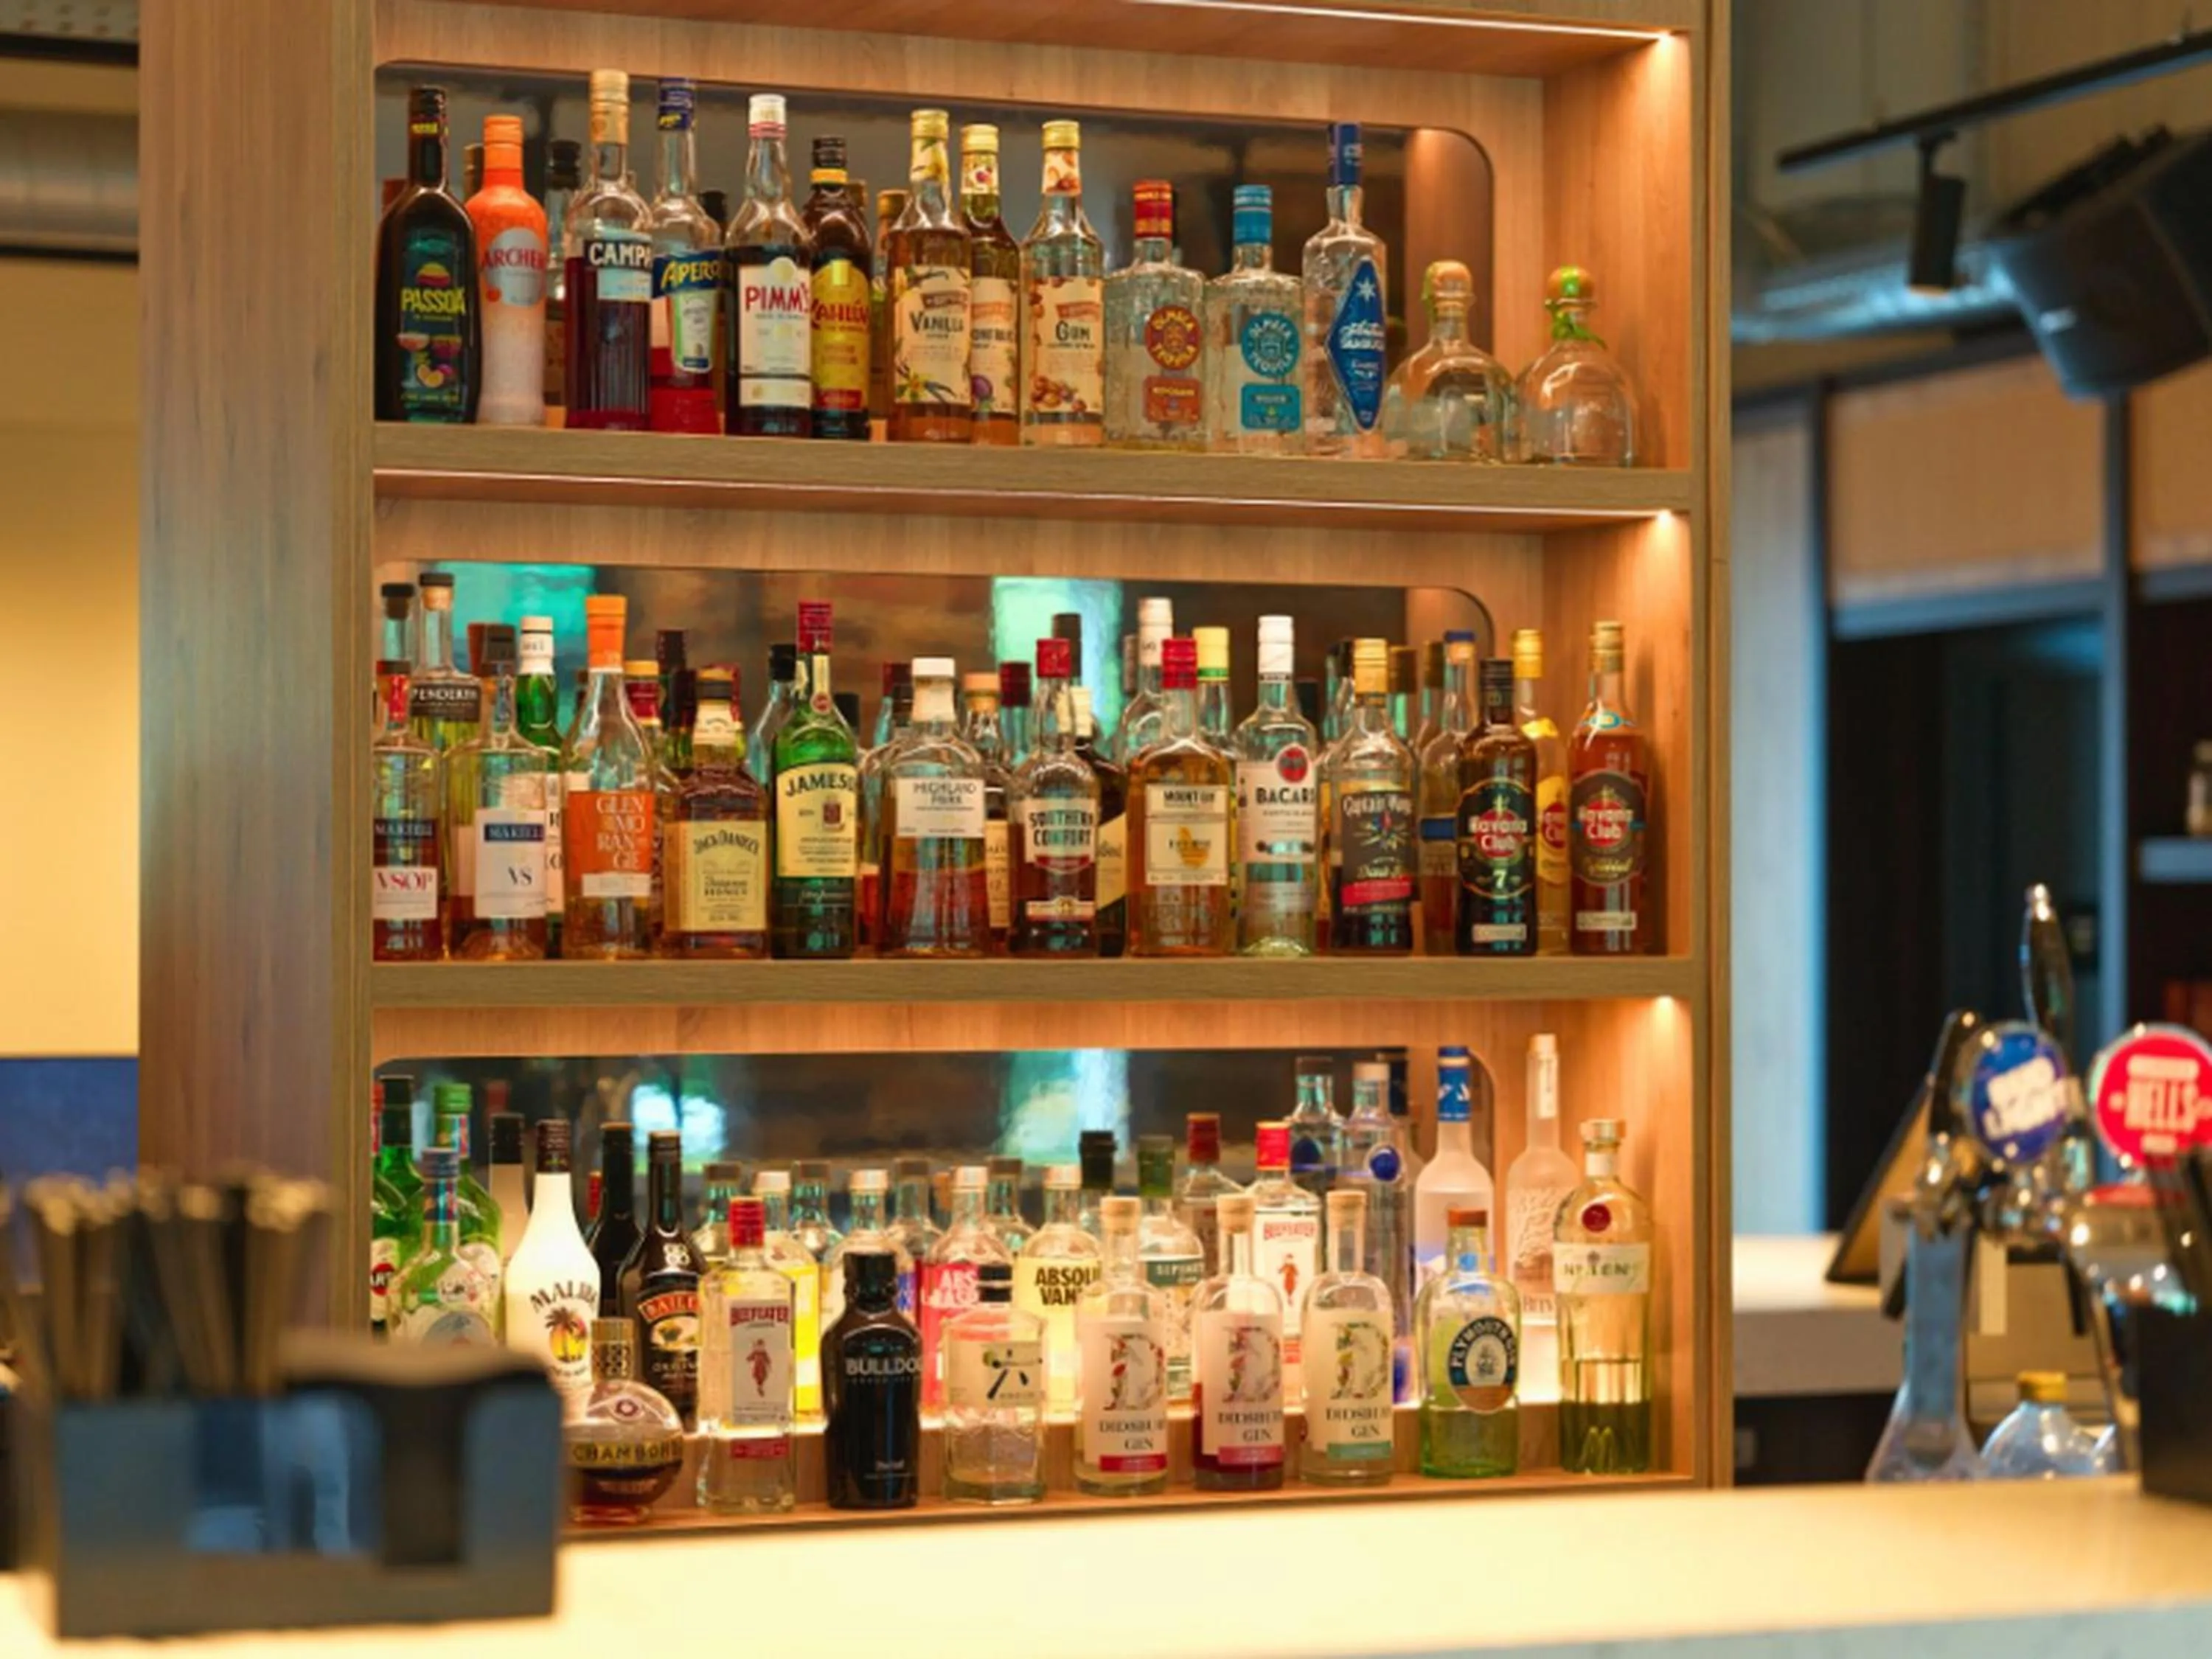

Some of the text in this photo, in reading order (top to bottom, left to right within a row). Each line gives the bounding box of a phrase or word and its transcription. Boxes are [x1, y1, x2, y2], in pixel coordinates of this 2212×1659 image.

[1493, 869, 1506, 888] 7
[1242, 1428, 1273, 1441] GIN
[1351, 1424, 1380, 1439] GIN
[1124, 1437, 1154, 1450] GIN
